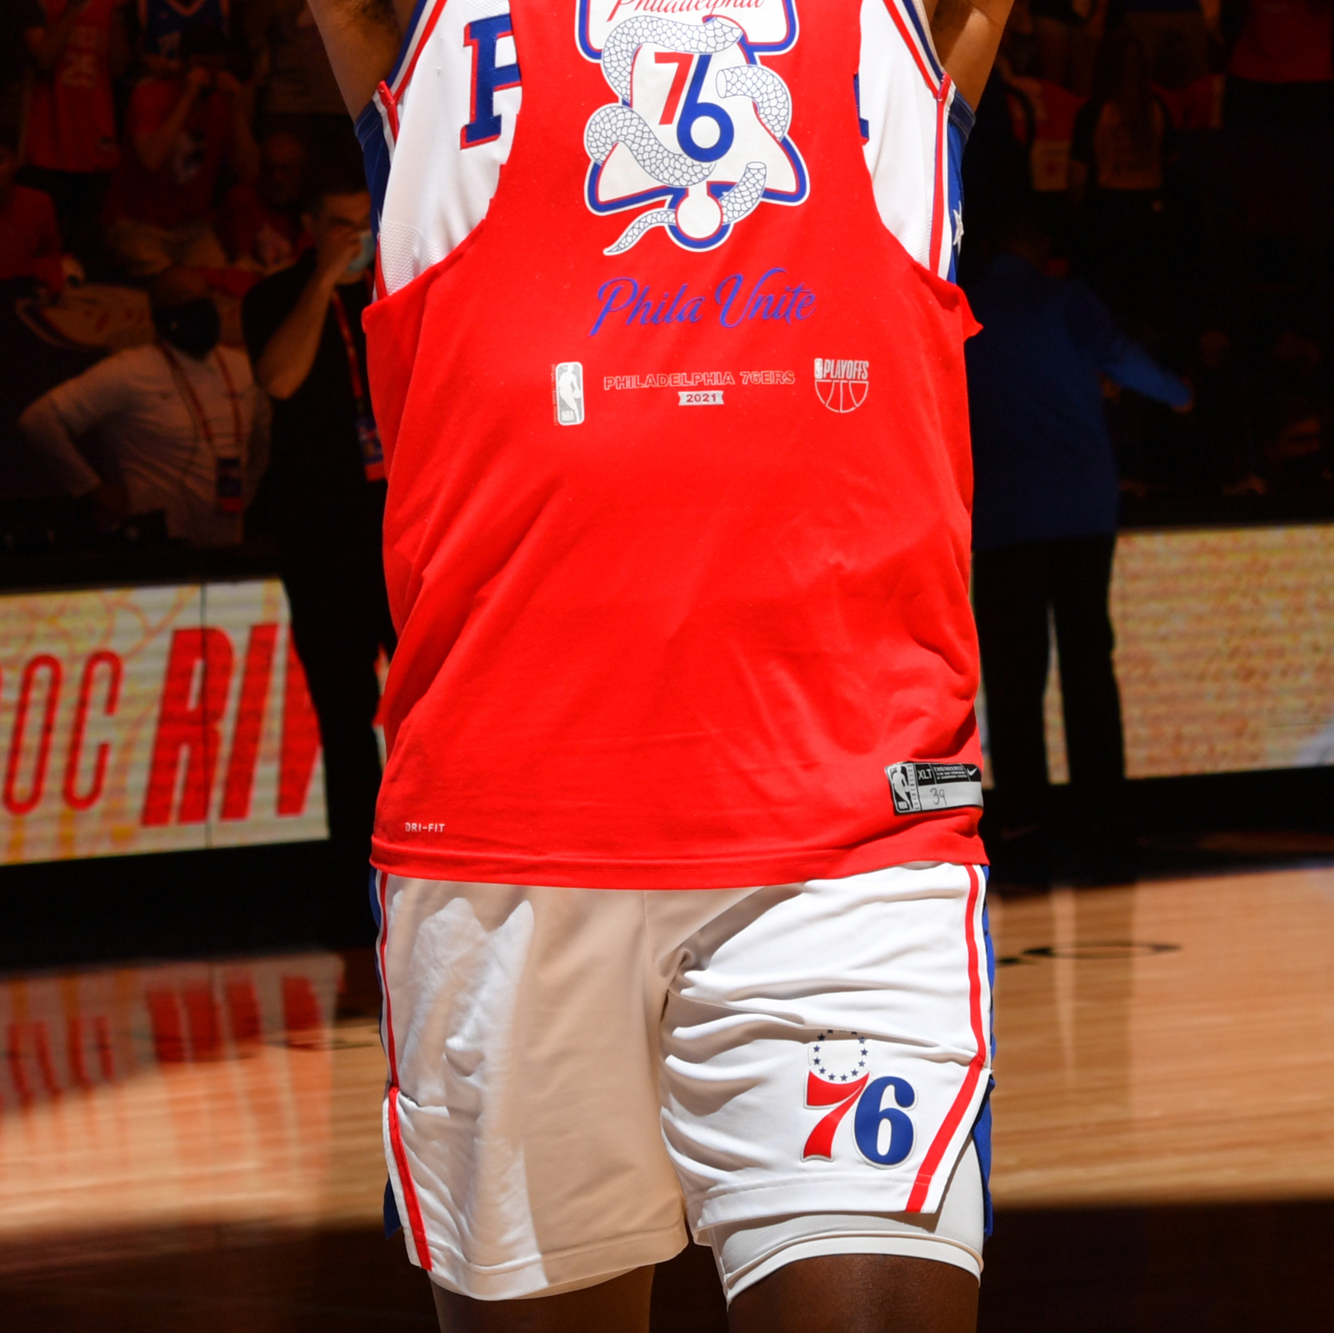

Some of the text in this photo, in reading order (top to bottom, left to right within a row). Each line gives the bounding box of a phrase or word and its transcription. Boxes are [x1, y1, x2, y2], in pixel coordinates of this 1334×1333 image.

[654, 52, 735, 162] 76
[588, 267, 817, 337] Phila Unite
[824, 359, 869, 380] PLAYOFFS
[603, 370, 796, 391] PHILADELPHIA 76ERS
[685, 393, 718, 404] 2021
[142, 623, 323, 829] RIV
[917, 769, 933, 781] XLT
[404, 822, 446, 833] DRI-FIT
[803, 1069, 916, 1166] 76
